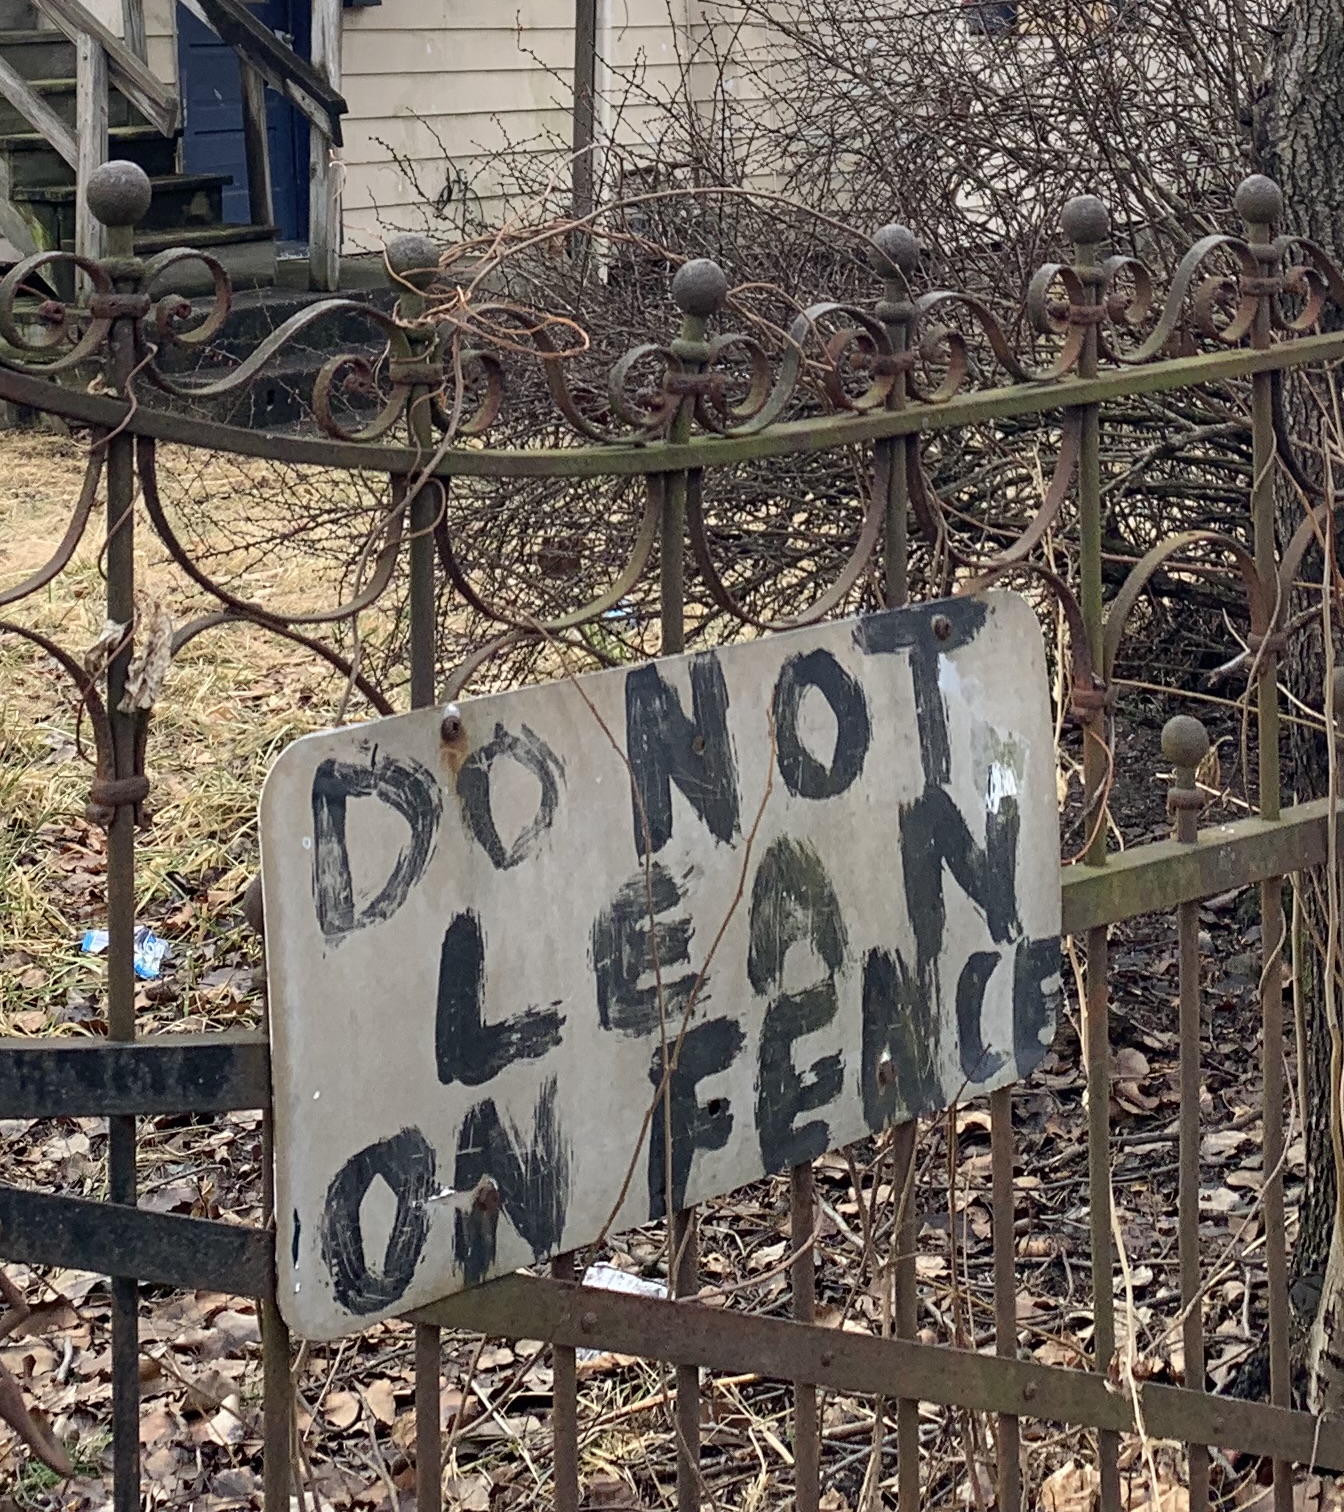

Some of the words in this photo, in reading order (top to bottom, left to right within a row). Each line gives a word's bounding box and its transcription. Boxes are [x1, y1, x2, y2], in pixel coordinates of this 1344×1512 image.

[311, 722, 567, 942] DO
[624, 596, 997, 858] NOT
[435, 784, 1022, 1086] LEAN
[321, 1074, 575, 1317] ON
[648, 935, 1062, 1222] FENCE
